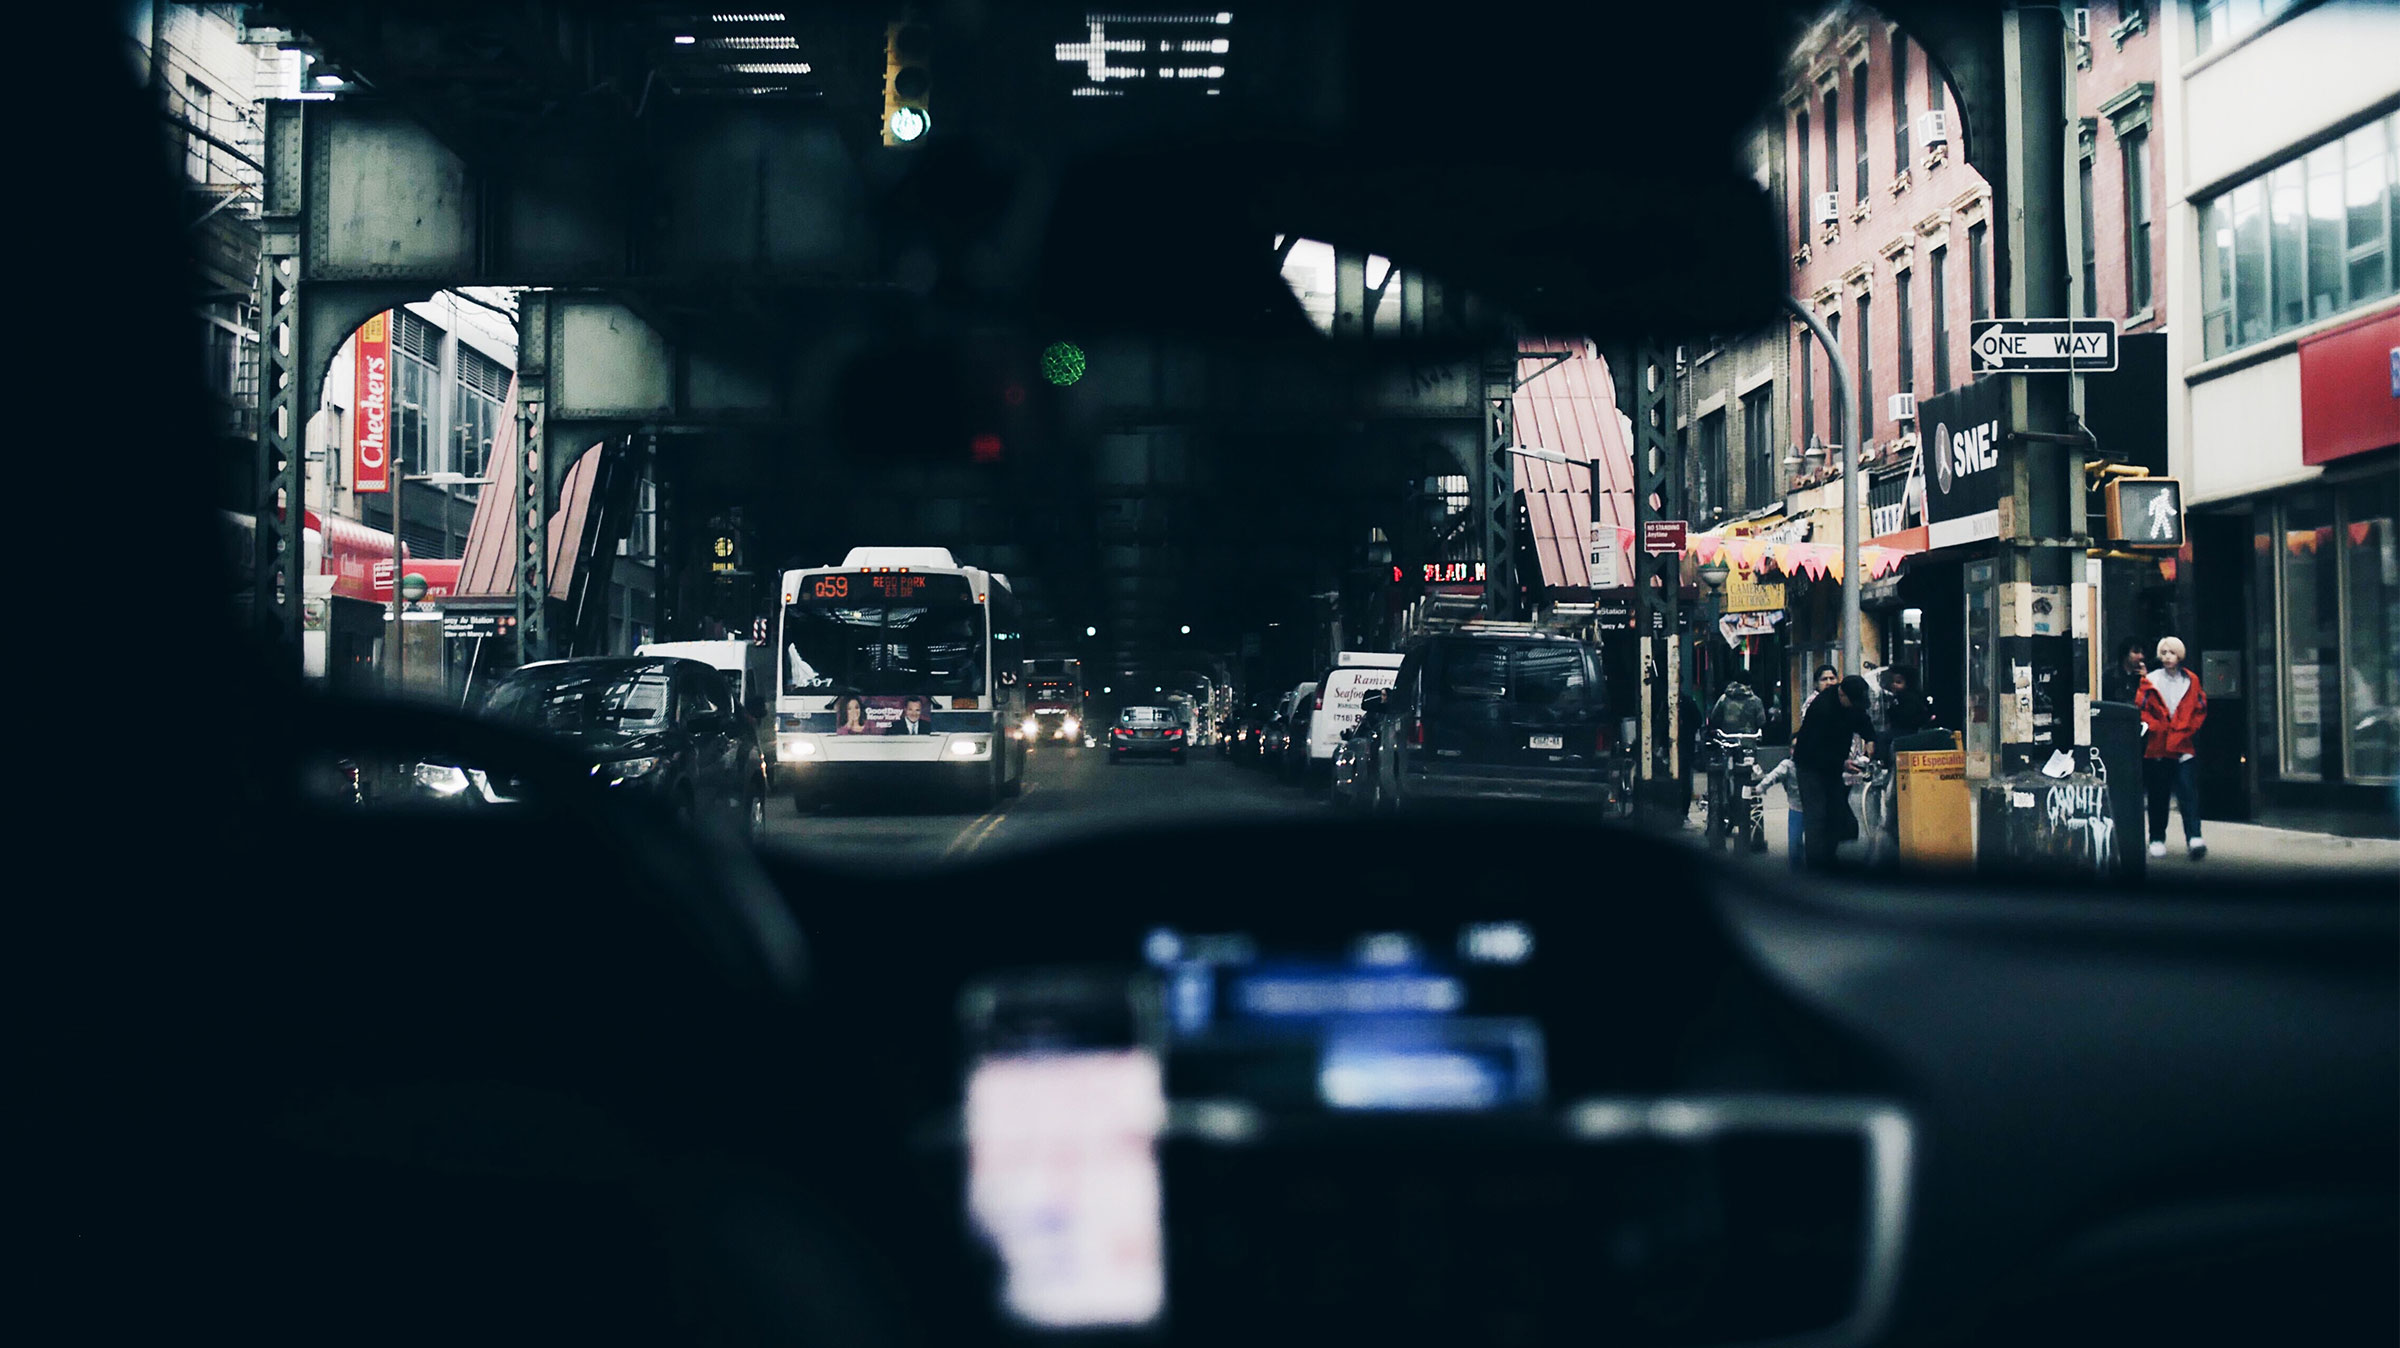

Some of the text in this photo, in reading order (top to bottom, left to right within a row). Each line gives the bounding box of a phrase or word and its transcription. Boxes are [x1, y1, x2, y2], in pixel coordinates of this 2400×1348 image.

[1983, 336, 2101, 355] ONE WAY
[360, 357, 385, 468] Checkers
[815, 576, 848, 598] Q59
[1912, 756, 1920, 767] El
